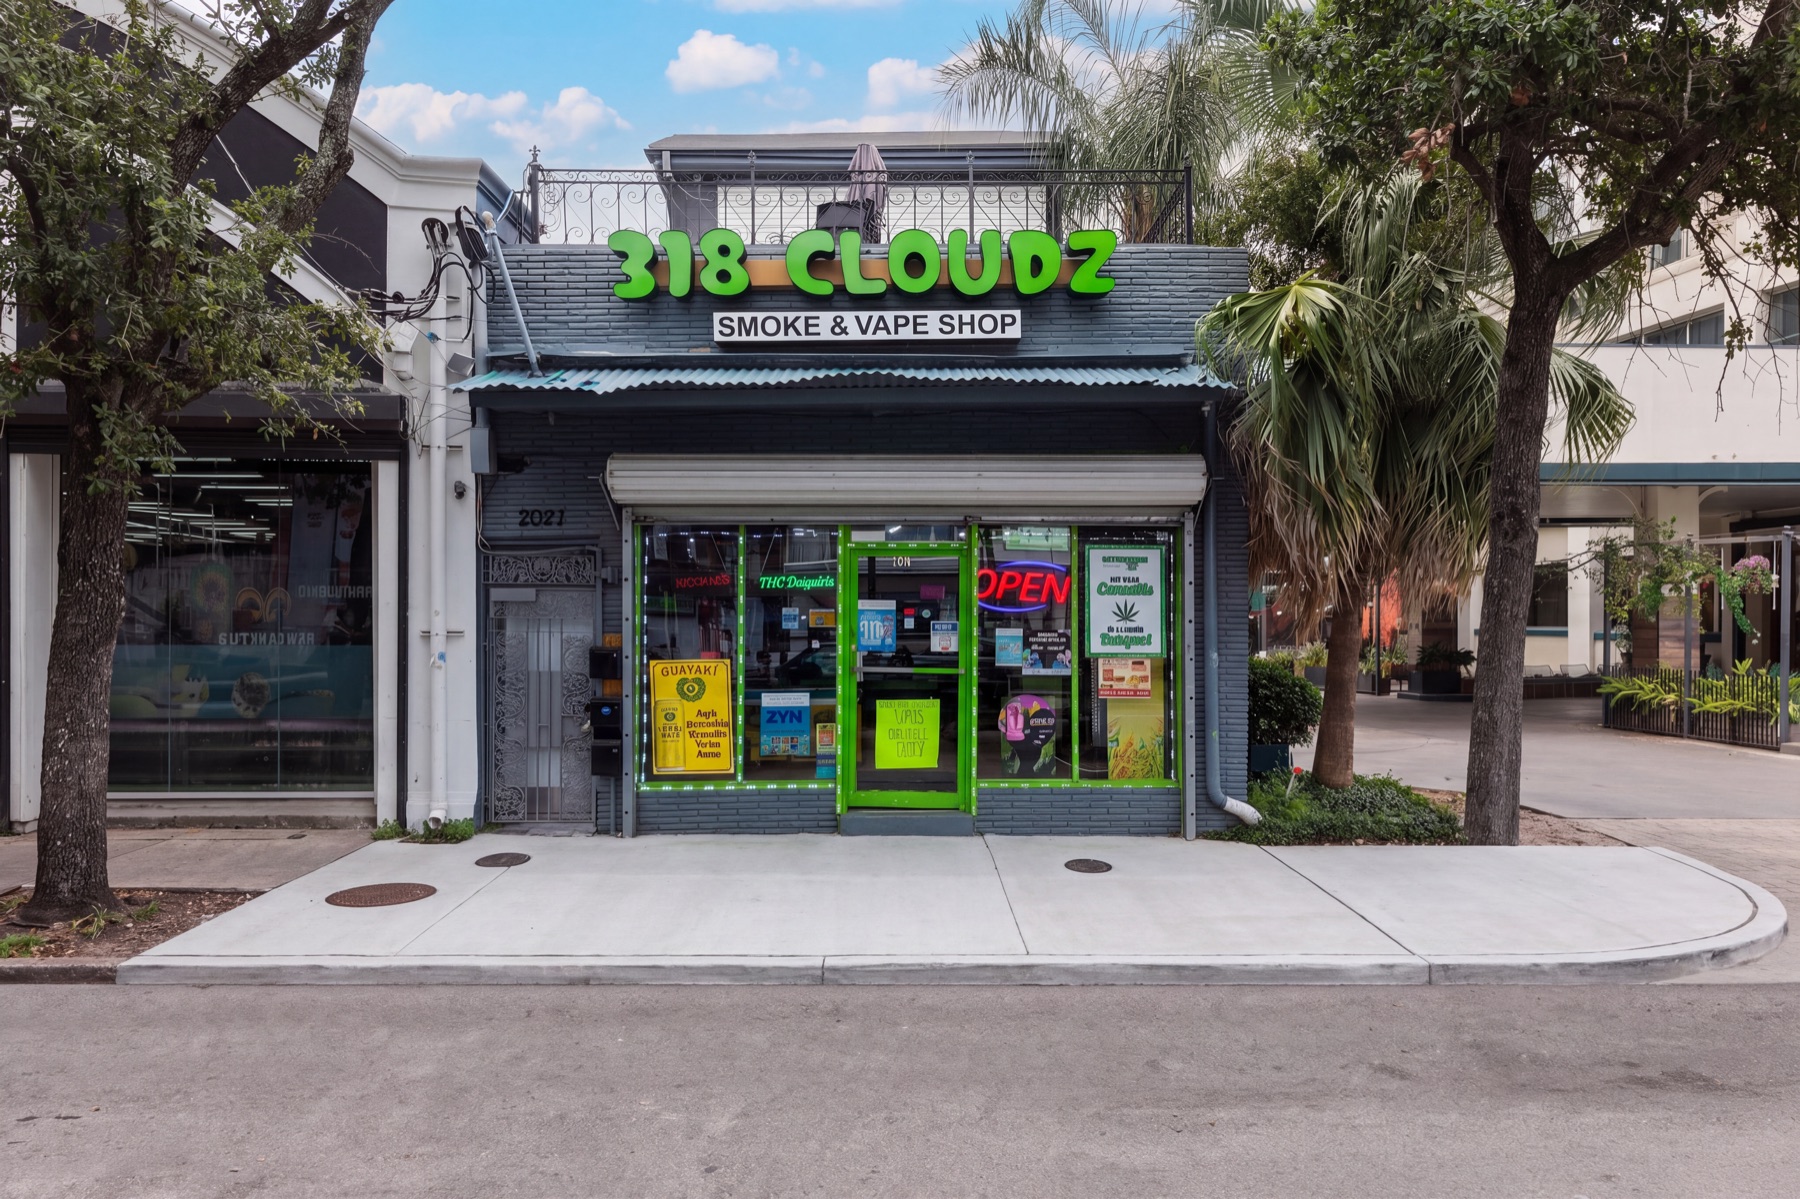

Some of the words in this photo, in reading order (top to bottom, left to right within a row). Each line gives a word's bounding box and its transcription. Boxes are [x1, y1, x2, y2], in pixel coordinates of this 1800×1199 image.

[608, 228, 750, 301] 318
[786, 228, 1118, 299] CLOUDZ
[718, 315, 821, 338] SMOKE
[830, 314, 848, 336] &
[855, 314, 930, 336] VAPE
[938, 313, 1017, 335] SHOP
[519, 510, 565, 526] 2021
[760, 576, 785, 589] THC
[787, 575, 834, 591] Daiquiris
[978, 568, 1071, 604] OPEN
[766, 710, 802, 724] ZYN
